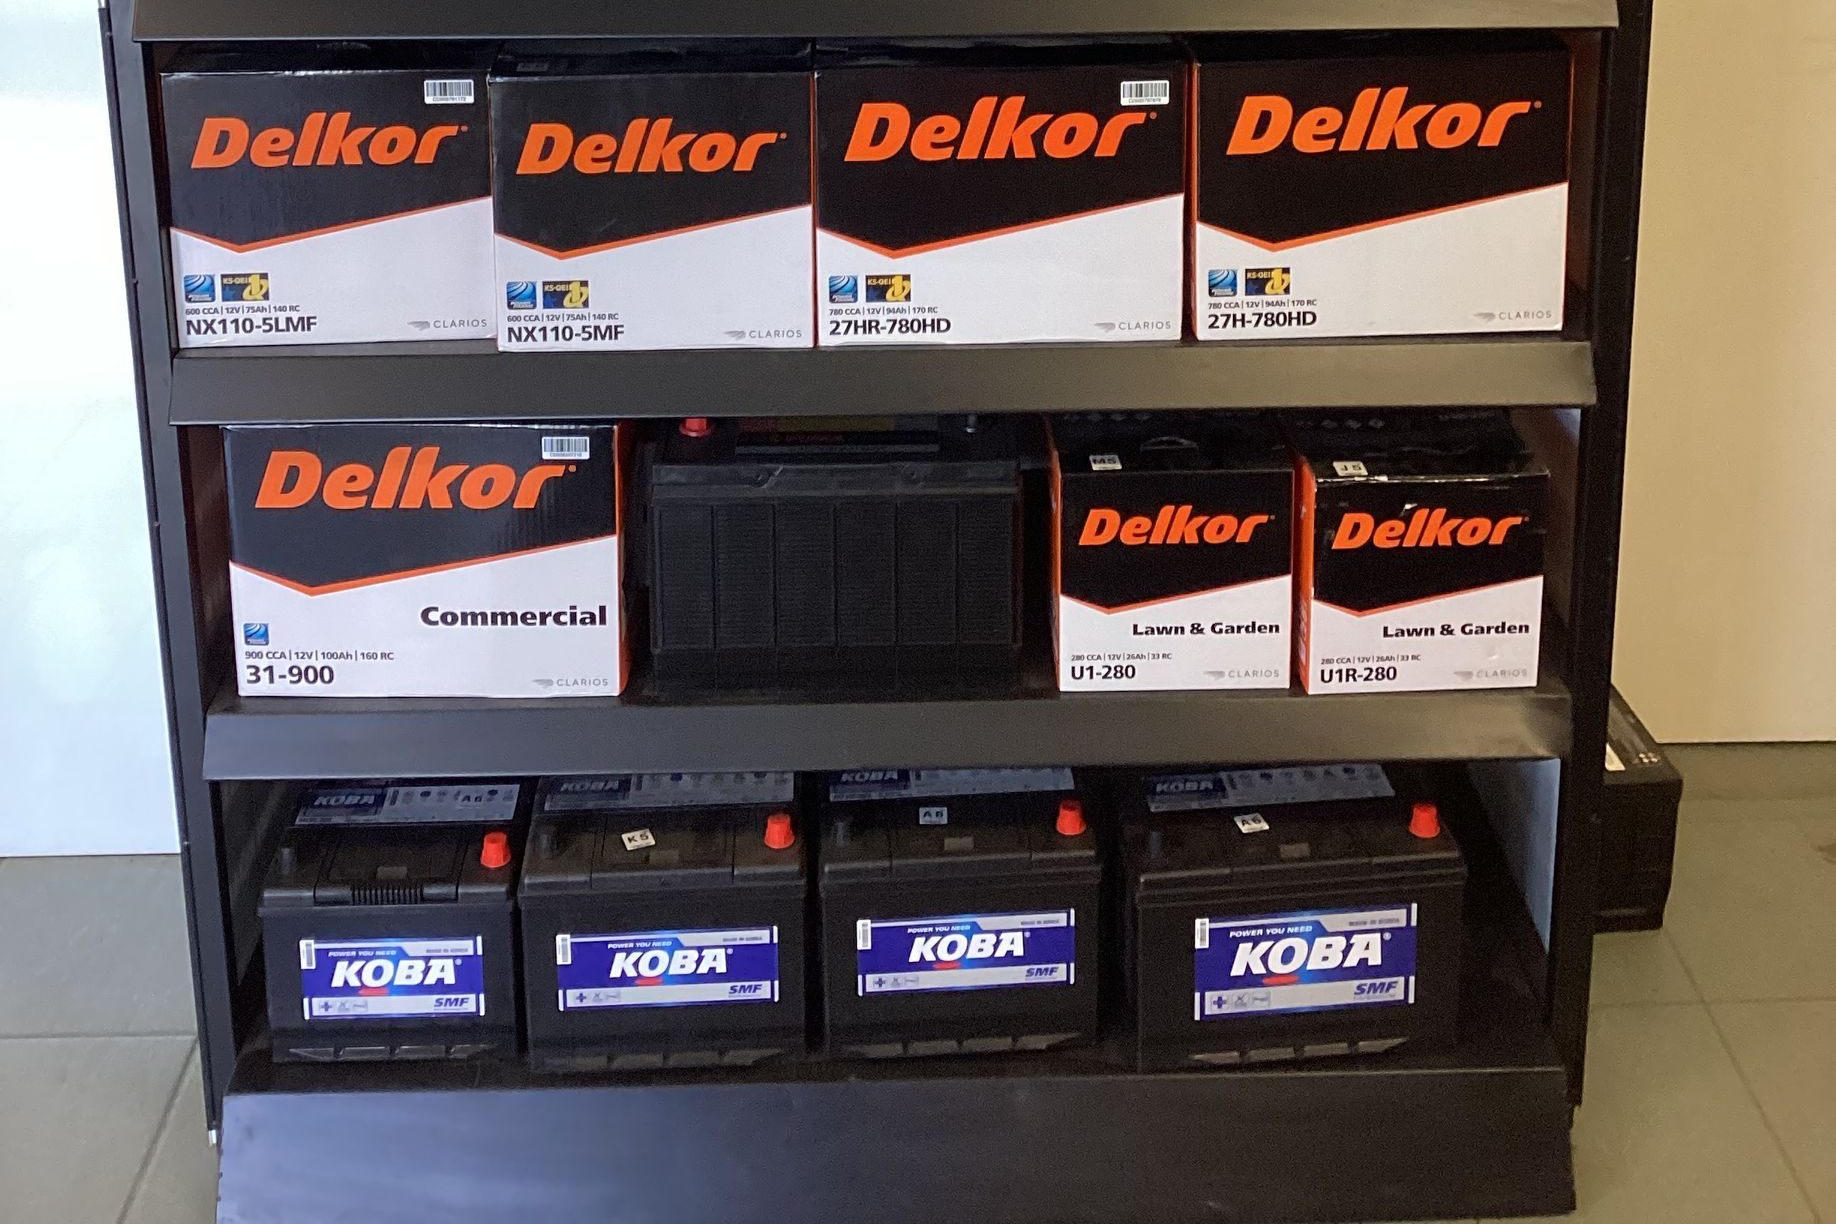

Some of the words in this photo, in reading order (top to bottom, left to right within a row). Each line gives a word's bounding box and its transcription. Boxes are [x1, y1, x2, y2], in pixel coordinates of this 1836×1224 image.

[844, 95, 1147, 162] Delkor
[1226, 86, 1532, 156] Delkor
[191, 112, 458, 169] Delkor
[516, 117, 778, 175] Delkor
[246, 306, 267, 314] 75Ah
[886, 307, 907, 315] 94Ah
[1265, 300, 1286, 308] 94Ah
[566, 313, 587, 321] 75Ah
[1208, 311, 1317, 329] 27H-780HD
[1499, 310, 1552, 321] CLARIOS
[186, 316, 317, 335] NX110-5LMF
[433, 319, 488, 329] CLARIOS
[829, 318, 952, 335] 27HR-780HD
[1118, 321, 1171, 331] CLARIOS
[507, 325, 625, 343] NX110-5MF
[749, 329, 802, 339] CLARIOS
[255, 446, 566, 510] Delkor
[1078, 505, 1269, 546] Delkor
[1331, 508, 1522, 550] Delkor
[420, 605, 607, 627] Commercial
[1132, 622, 1185, 636] Lawn
[1189, 622, 1206, 635] &
[1210, 621, 1280, 635] Garden
[1383, 625, 1435, 638] Lawn
[1439, 624, 1456, 636] &
[1460, 622, 1530, 635] Garden
[245, 651, 263, 659] 900
[266, 651, 287, 659] CCA
[295, 651, 313, 659] 12V
[321, 650, 353, 660] 100Ah
[360, 652, 378, 660] 160
[381, 652, 395, 660] RC
[246, 665, 335, 684] 31-900
[1071, 665, 1136, 680] U1-280
[1228, 669, 1280, 678] CLARIOS
[1320, 666, 1397, 683] U1R-280
[556, 678, 609, 688] CLARIOS
[1229, 929, 1263, 938] POWER
[1265, 927, 1285, 936] YOU
[1287, 925, 1313, 934] NEED
[908, 931, 1024, 963] KOBA
[1230, 933, 1382, 977] KOBA
[609, 948, 727, 978] KOBA
[331, 958, 456, 988] KOBA
[1025, 966, 1060, 977] SMF
[728, 984, 763, 994] SMF
[1353, 980, 1398, 996] SMF
[434, 997, 470, 1008] SMF
